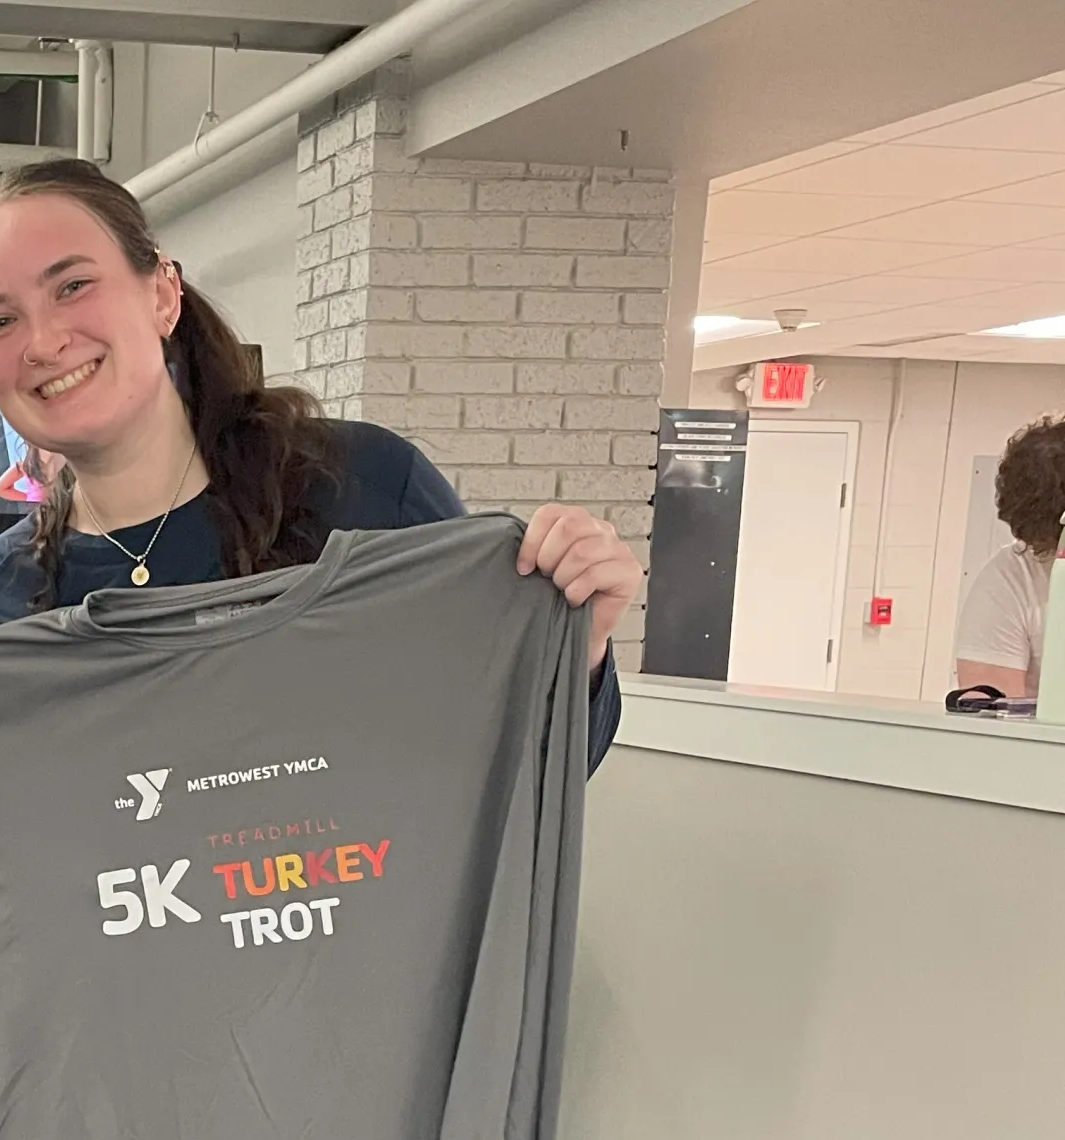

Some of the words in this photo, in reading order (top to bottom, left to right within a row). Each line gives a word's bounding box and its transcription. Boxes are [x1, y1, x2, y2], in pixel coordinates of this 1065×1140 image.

[763, 363, 808, 401] EXIT
[114, 797, 135, 810] the
[126, 768, 169, 821] Y
[187, 764, 280, 792] METROWEST
[283, 757, 329, 776] YMCA
[207, 818, 341, 849] TREADMILL
[212, 839, 391, 900] TURKEY
[97, 858, 202, 936] 5K
[220, 897, 341, 949] TROT
